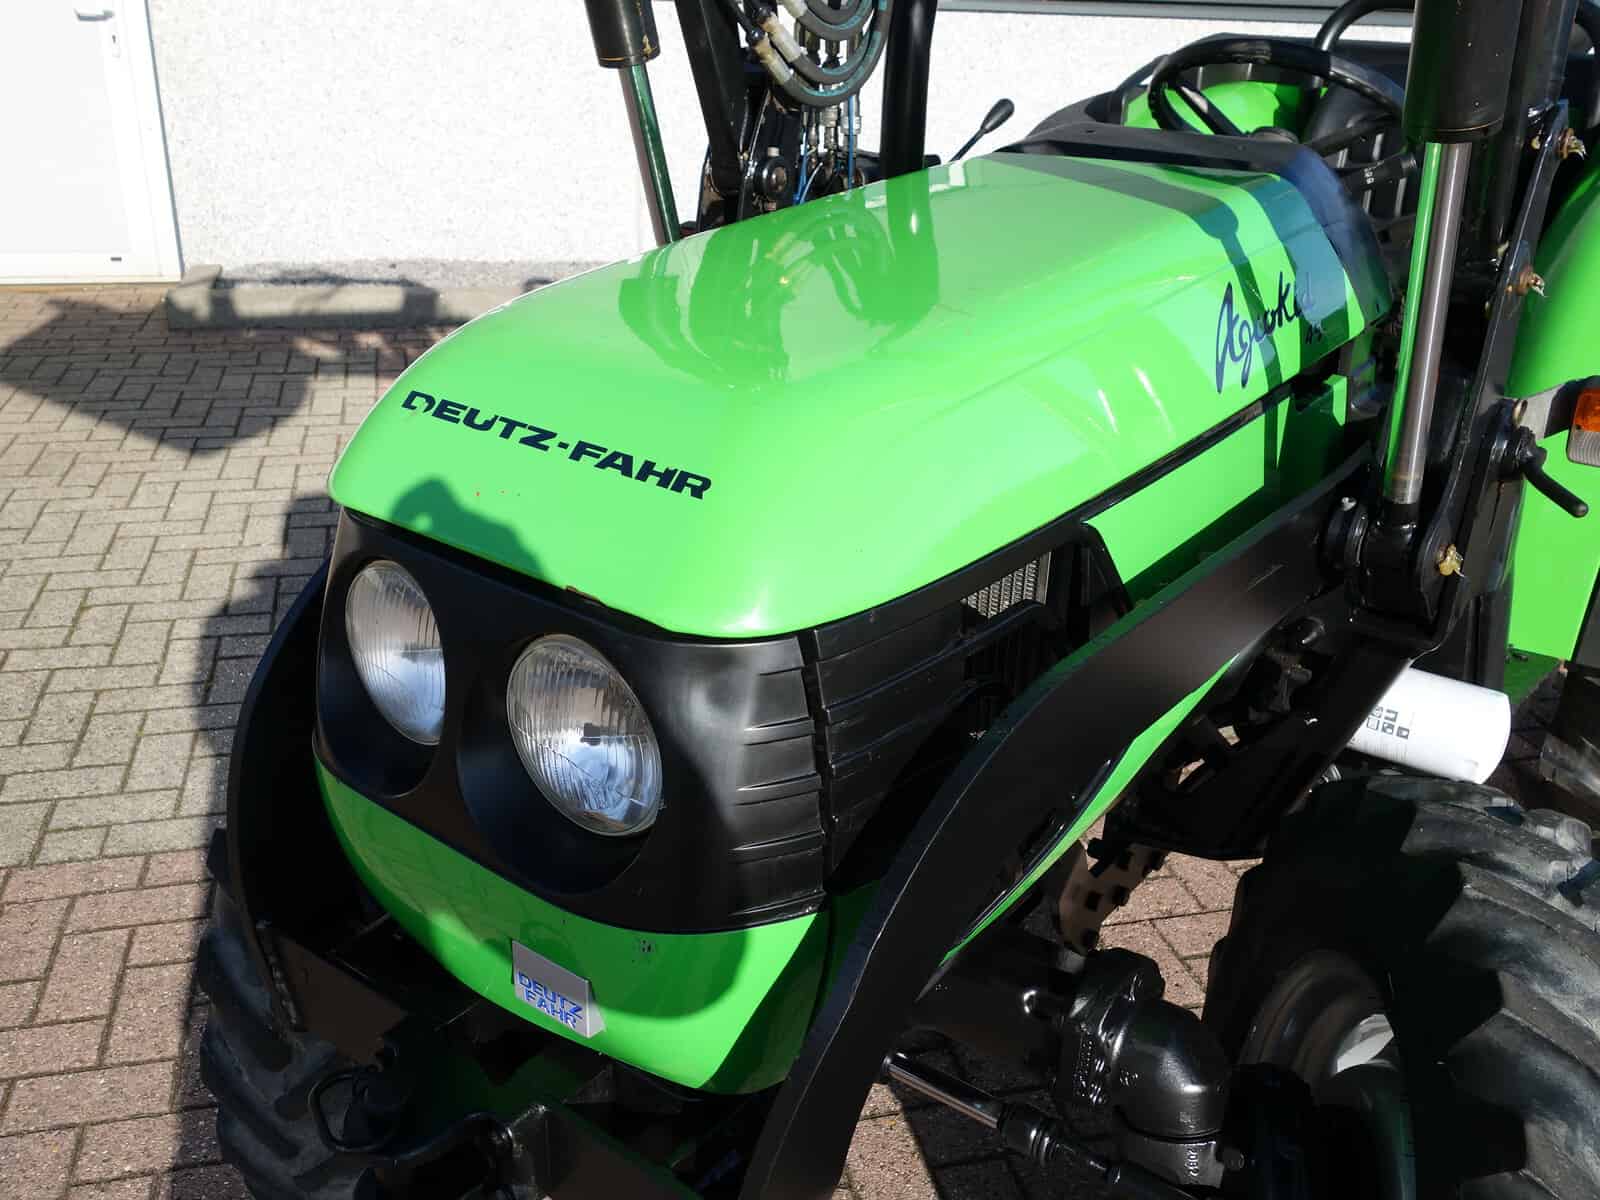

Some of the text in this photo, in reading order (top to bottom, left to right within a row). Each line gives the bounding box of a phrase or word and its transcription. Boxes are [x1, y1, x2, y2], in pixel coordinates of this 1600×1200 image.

[401, 390, 712, 500] DEUTZ-FAHR
[518, 971, 584, 1020] DEUTZ
[525, 988, 577, 1029] FAHR
